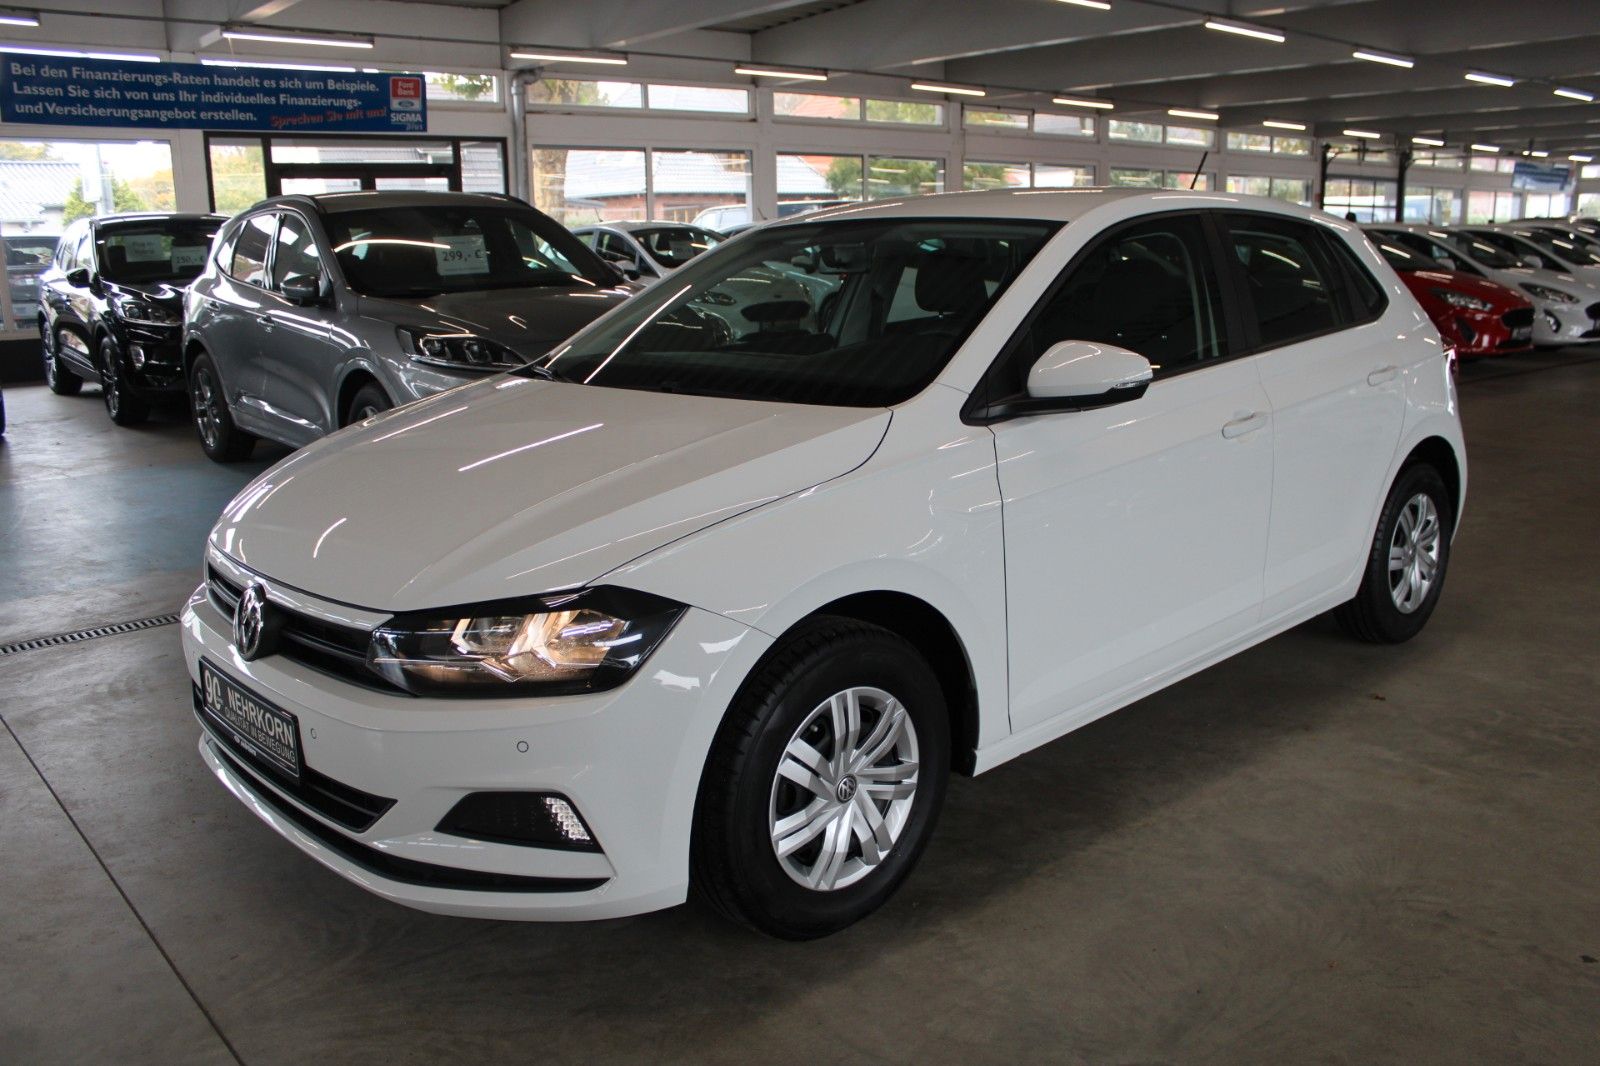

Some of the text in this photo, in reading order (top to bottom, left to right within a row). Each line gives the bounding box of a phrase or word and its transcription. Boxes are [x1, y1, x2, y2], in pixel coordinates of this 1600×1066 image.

[10, 62, 380, 94] Bei den Finanzierungs-Raten handelt es sich um Beispiele.
[13, 82, 362, 109] Lassen Sie sich von uns Ihr individuelles Finanzierungs-
[15, 102, 257, 122] und Versicherungsangebot erstellen.
[271, 114, 323, 128] Sprechen
[346, 108, 364, 120] mit
[391, 112, 423, 122] SIGMA
[227, 687, 294, 749] NEHRKORN
[257, 731, 296, 763] BEWEGUNG
